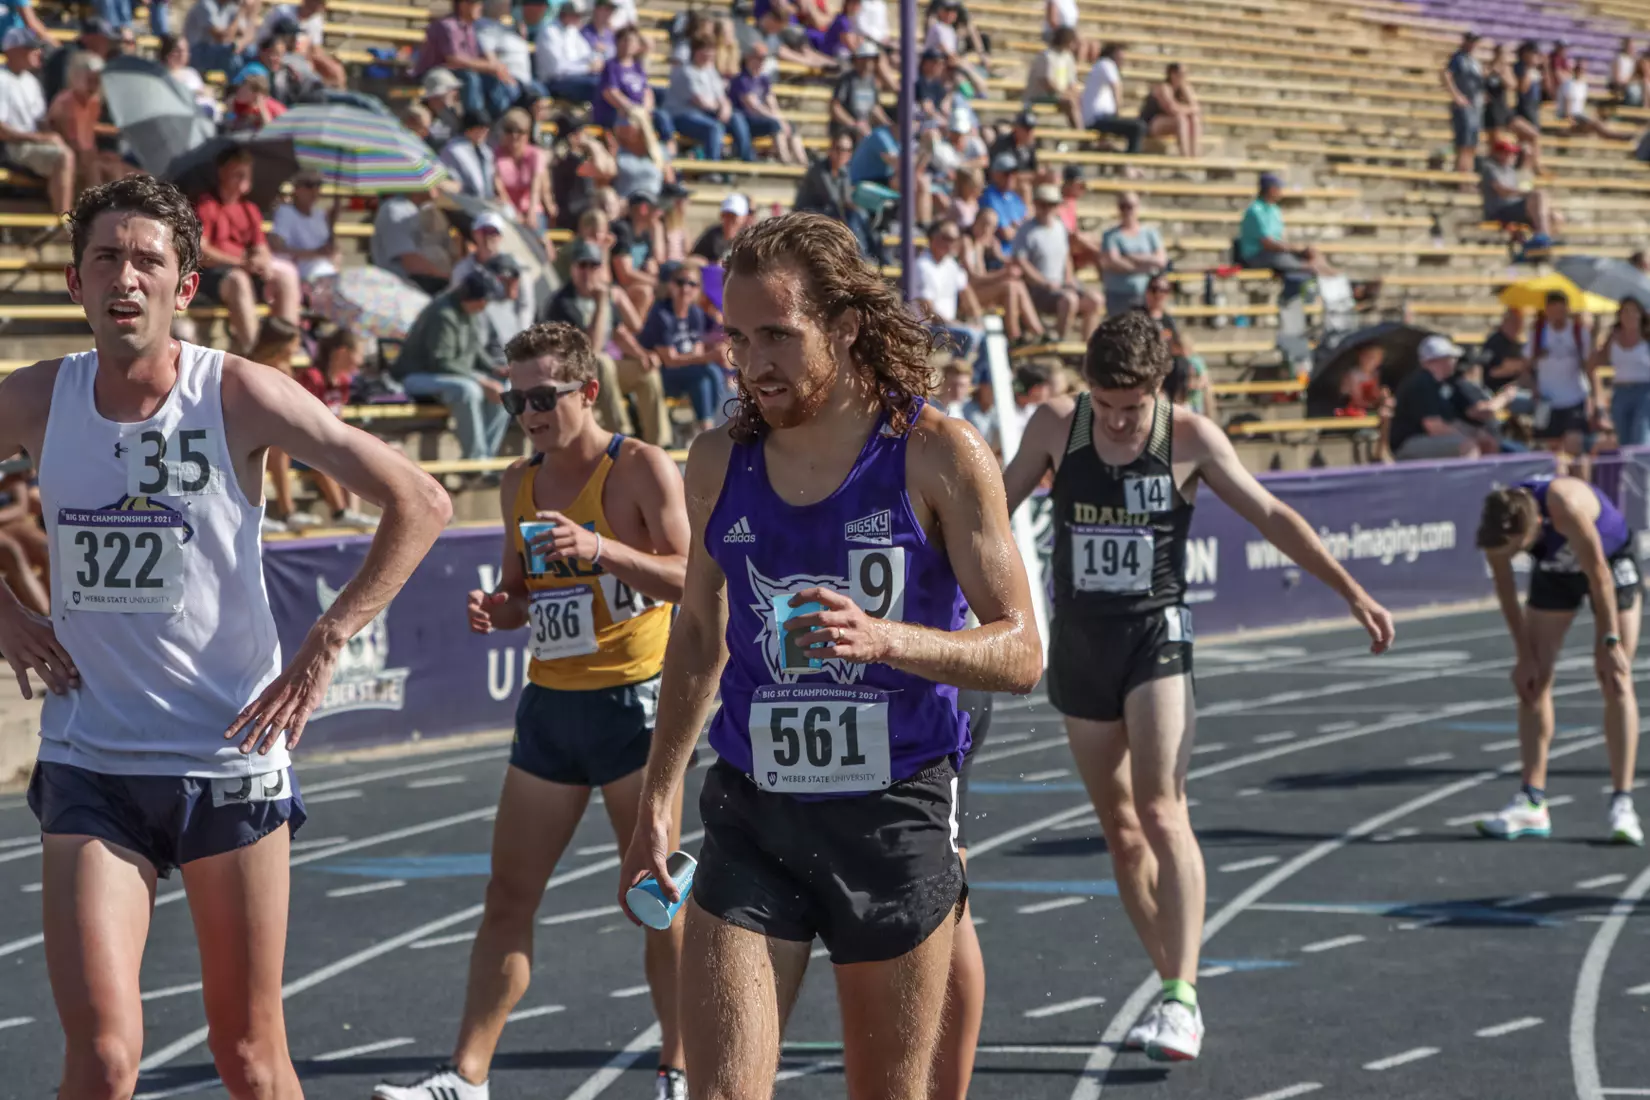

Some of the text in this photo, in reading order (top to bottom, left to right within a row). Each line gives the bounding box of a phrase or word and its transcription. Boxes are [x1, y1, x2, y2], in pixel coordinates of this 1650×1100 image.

[139, 429, 210, 494] 35
[1133, 479, 1165, 510] 14
[65, 513, 172, 523] BIG SKY CHAMPIONSHIPS 2021
[723, 533, 756, 543] adidas
[74, 530, 164, 588] 322
[1083, 538, 1141, 577] 194
[83, 595, 171, 604] WEBER STATE UNIVERSITY
[859, 552, 893, 620] 9
[534, 600, 580, 643] 386
[762, 688, 878, 700] BIG SKY CHAMPIONSHIPS 2021
[770, 705, 866, 768] 561
[781, 773, 876, 783] WEBER STATE UNIVERSITY
